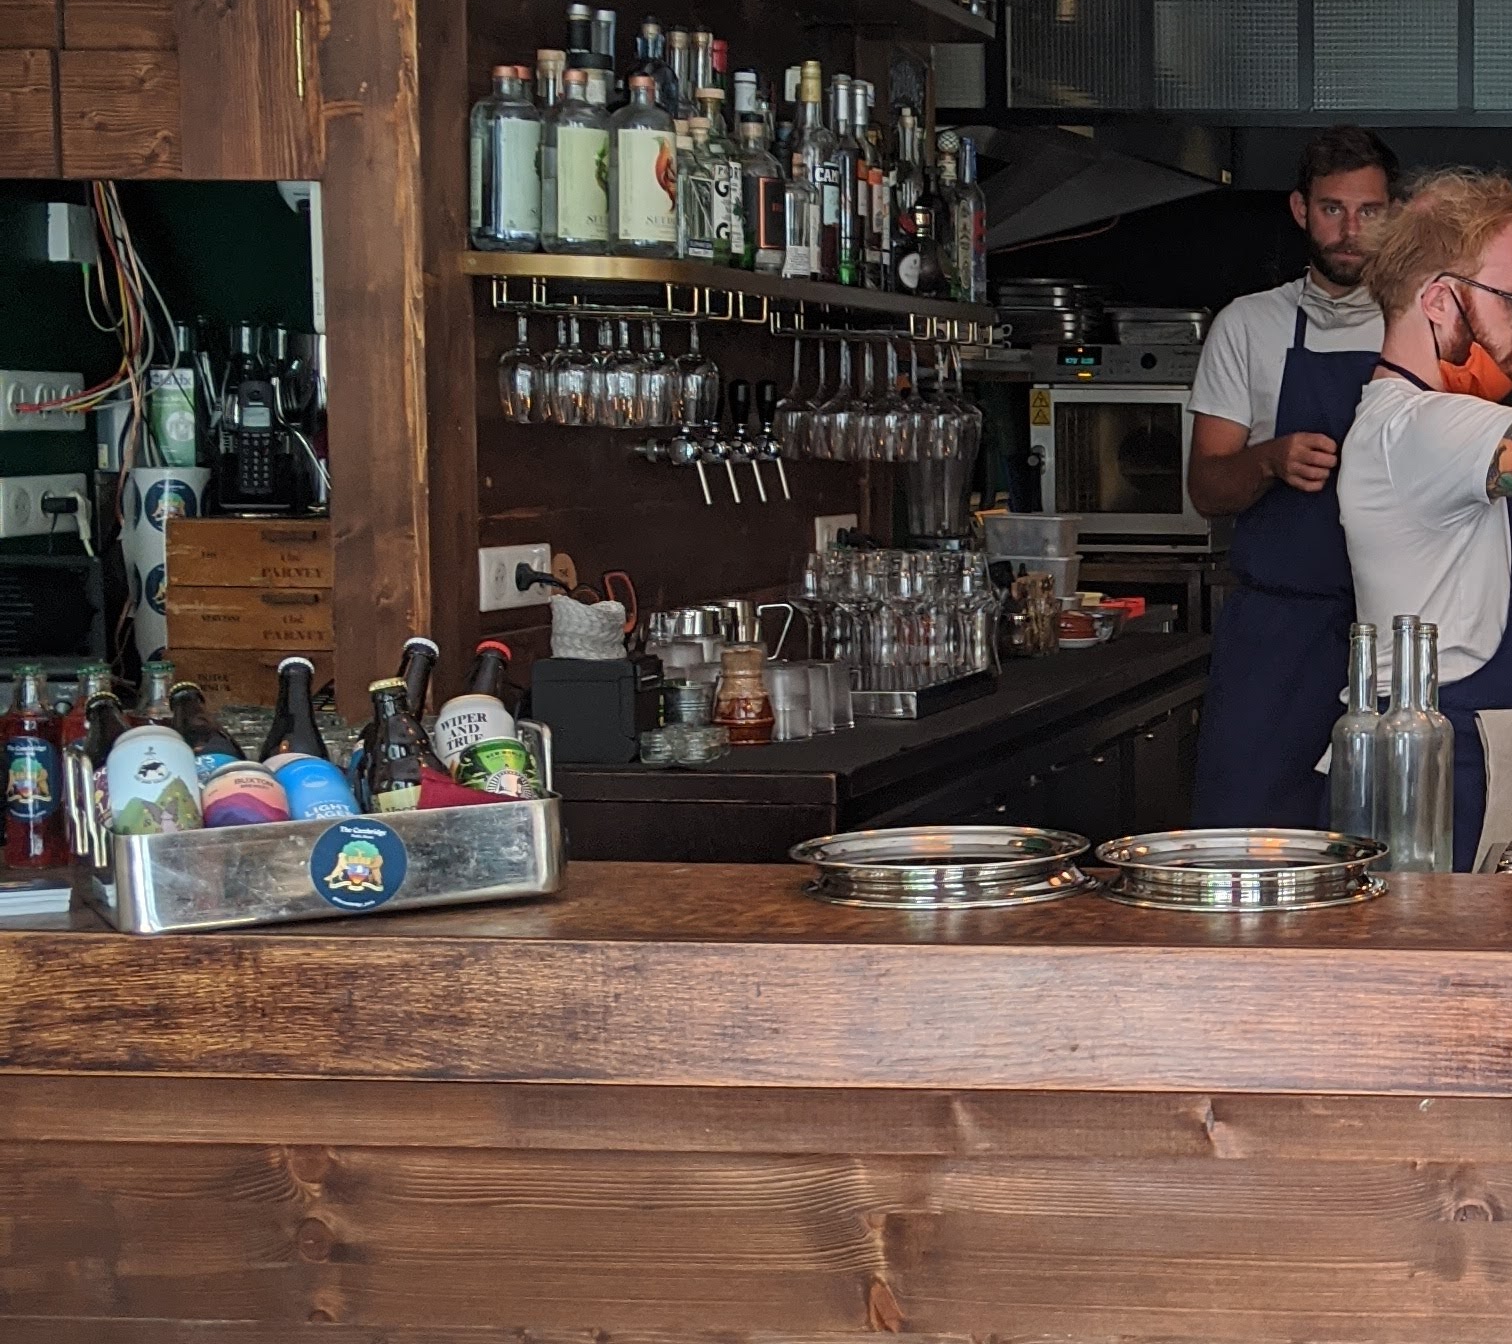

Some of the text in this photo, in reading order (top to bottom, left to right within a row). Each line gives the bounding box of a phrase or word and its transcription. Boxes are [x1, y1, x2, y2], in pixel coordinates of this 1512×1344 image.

[440, 712, 488, 732] WIPER
[449, 723, 480, 738] AND
[446, 734, 484, 752] TRUE
[234, 777, 274, 788] BUXTON
[304, 803, 351, 818] LIGHT
